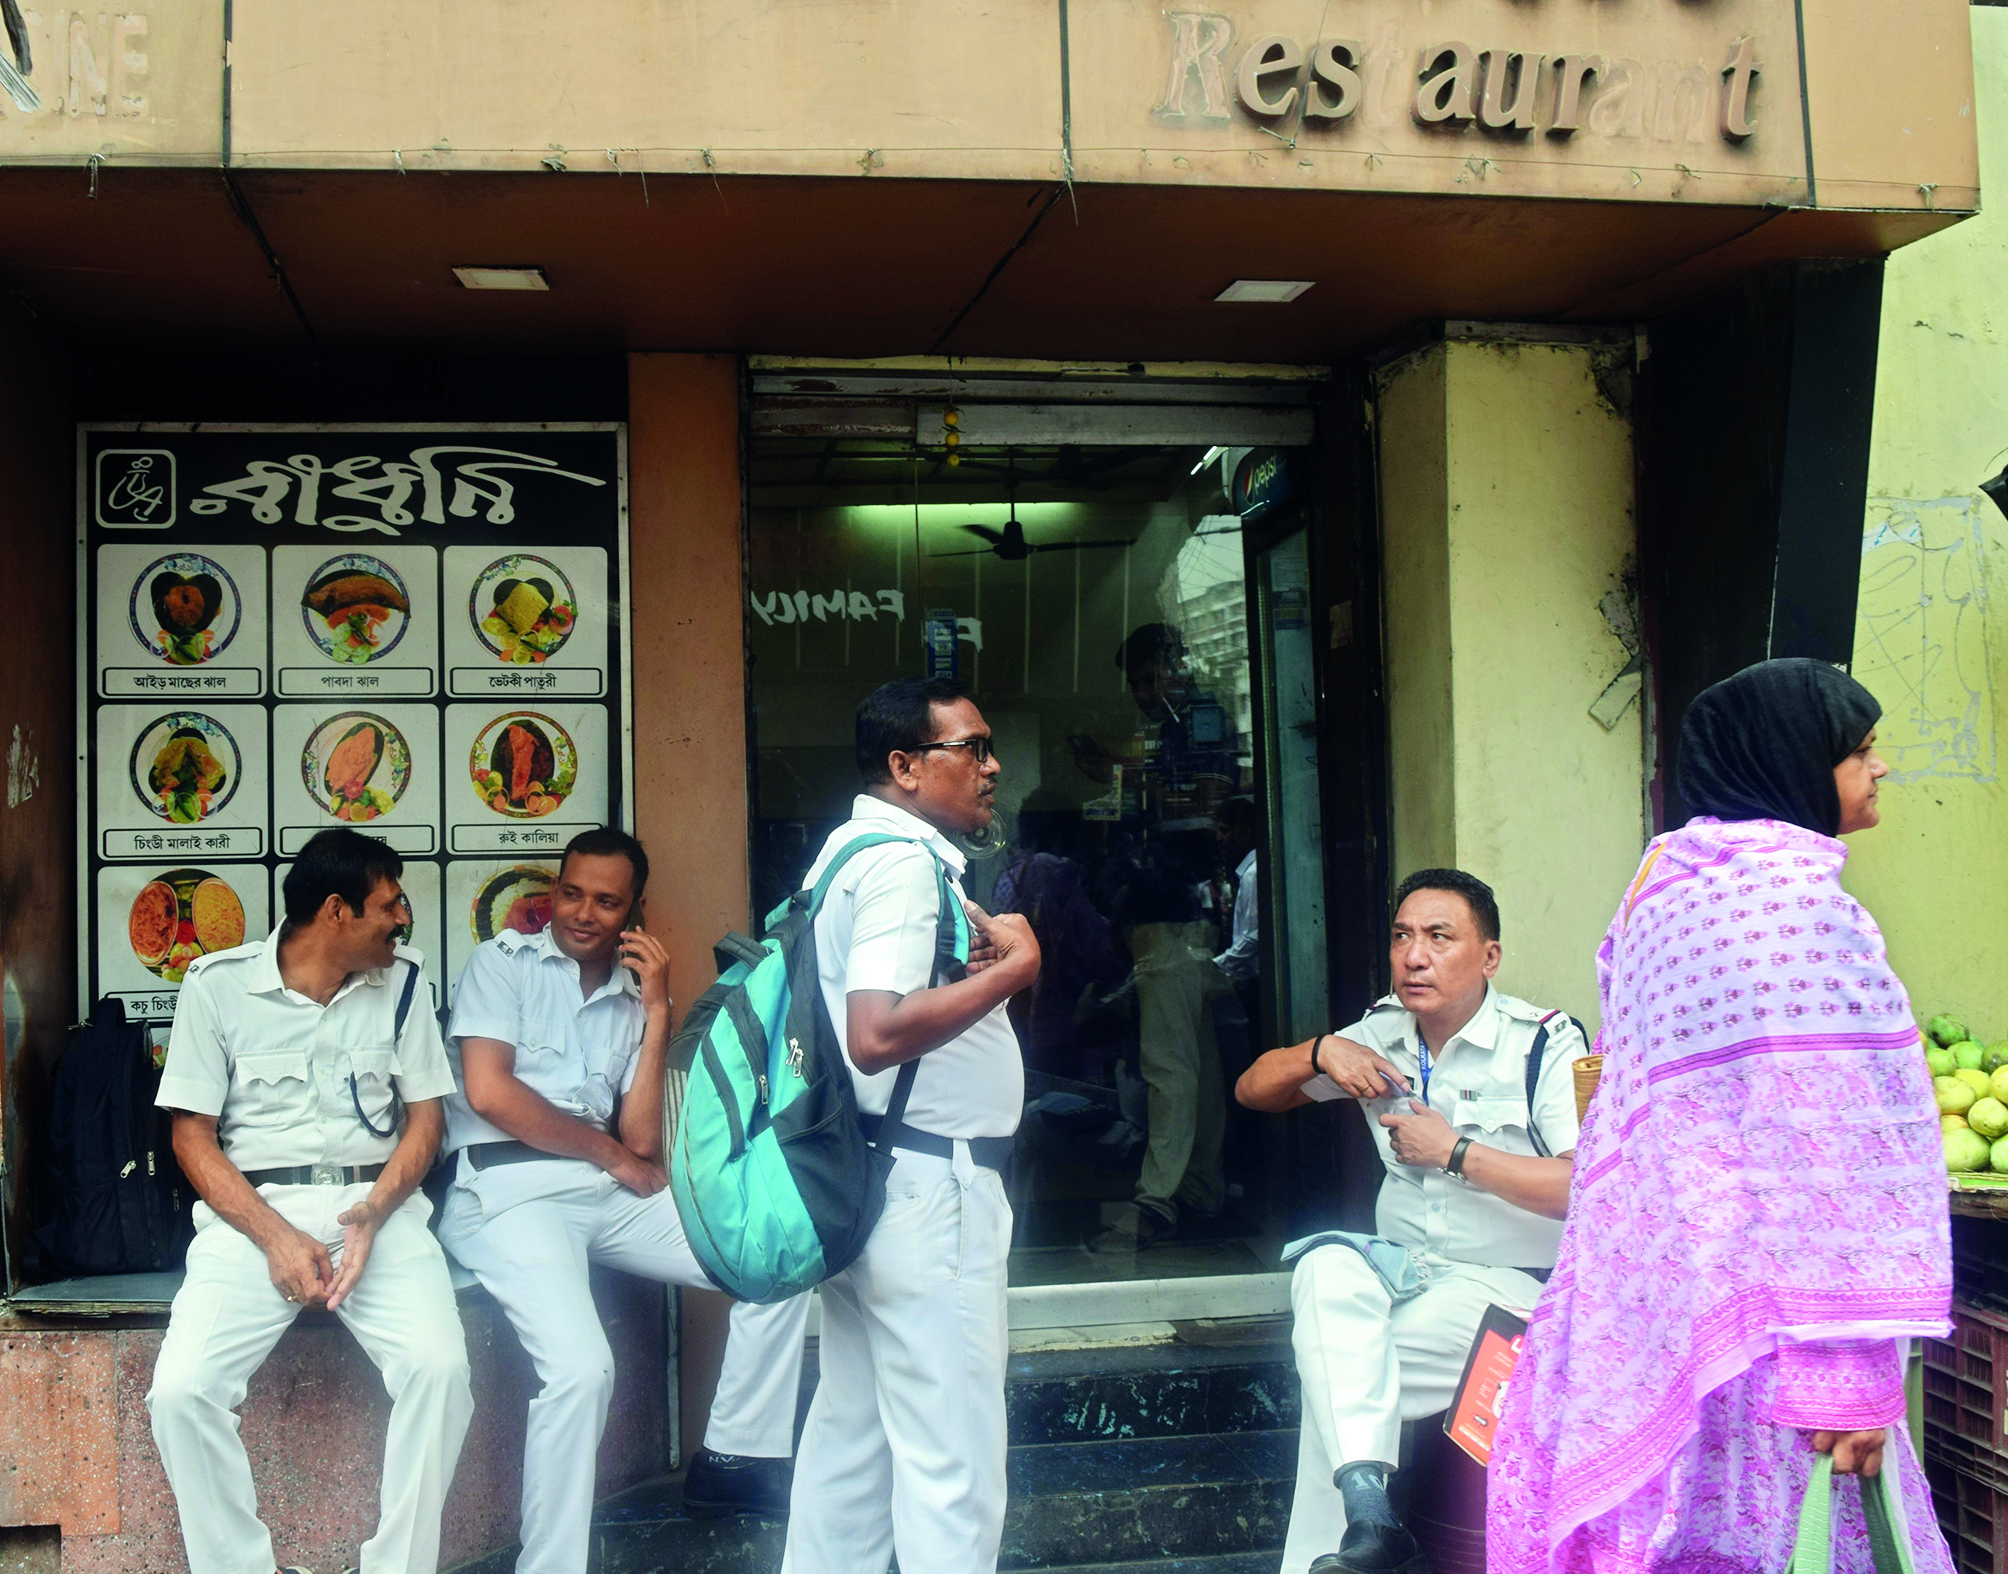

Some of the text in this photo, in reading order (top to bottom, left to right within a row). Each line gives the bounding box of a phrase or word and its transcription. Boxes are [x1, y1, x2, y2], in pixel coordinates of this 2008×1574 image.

[1153, 10, 1763, 143] Restaurant
[133, 674, 226, 690] আইড় মাছের ঝাল
[321, 675, 379, 688] পাবদা ঝাল
[488, 672, 557, 691] ভেটকী পাতুরী
[167, 835, 202, 850] মালাই
[205, 833, 231, 849] কারী
[498, 828, 559, 845] রুই কালিয়া
[130, 1000, 149, 1015] কচু
